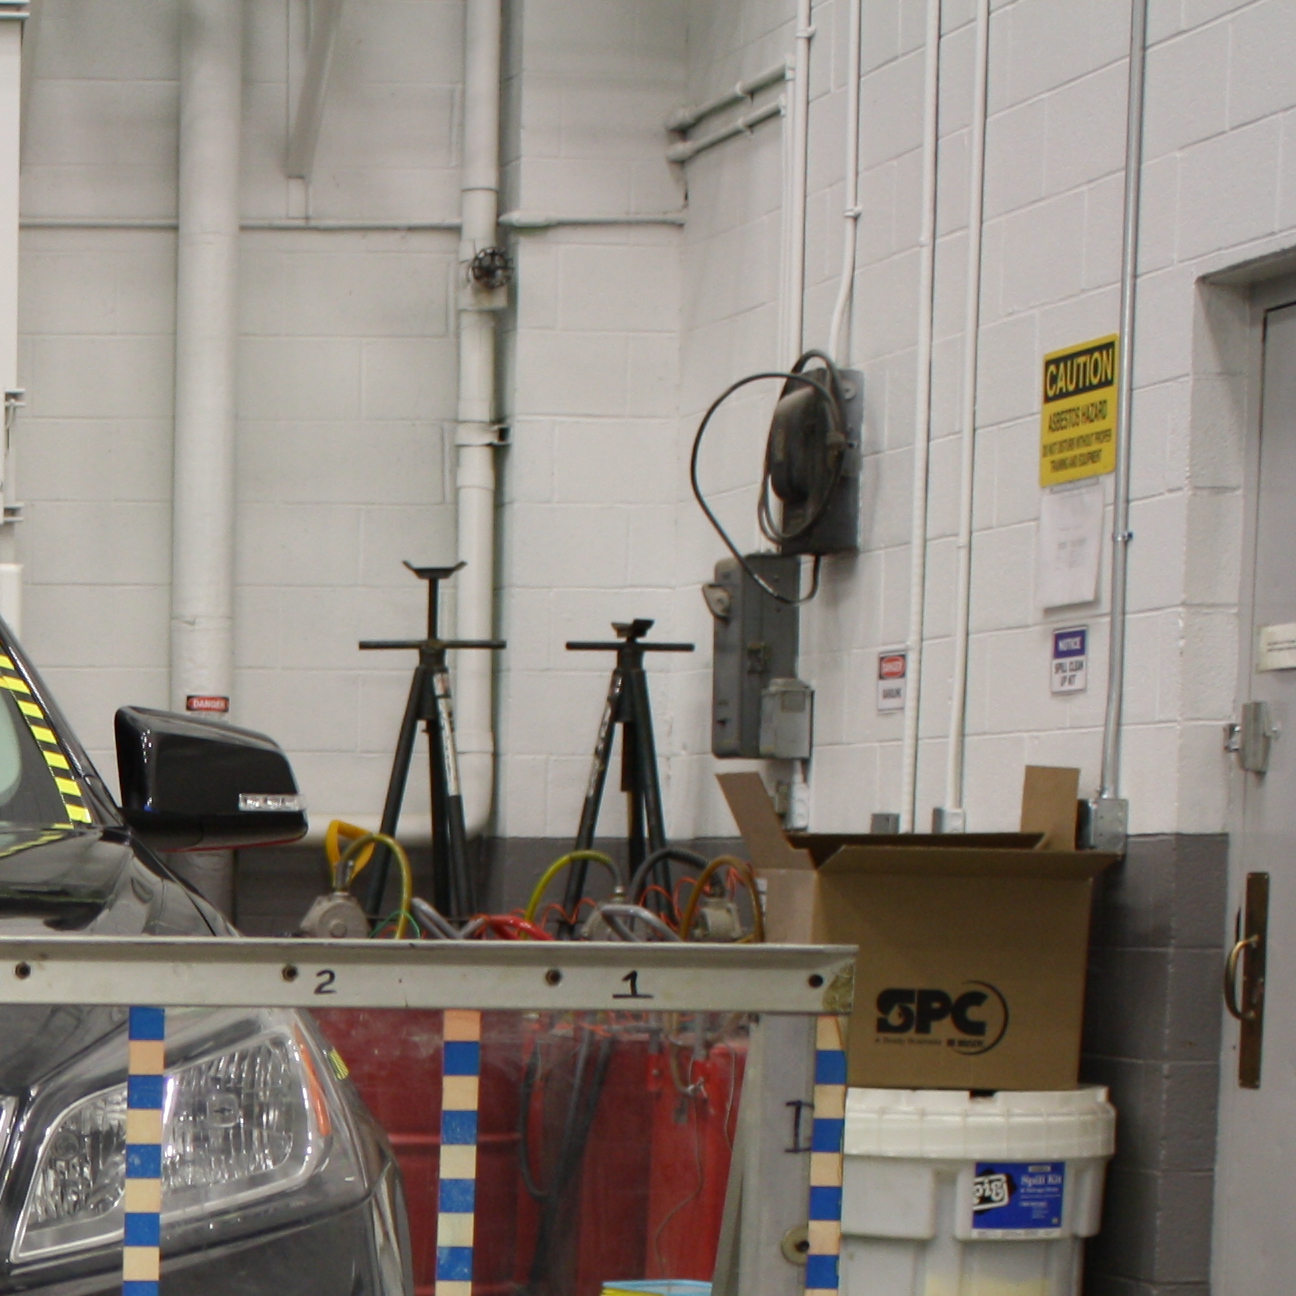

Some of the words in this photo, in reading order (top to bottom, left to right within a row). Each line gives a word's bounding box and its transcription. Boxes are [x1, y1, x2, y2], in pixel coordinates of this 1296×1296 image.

[1046, 348, 1112, 397] CAUTION
[313, 969, 337, 995] 2
[612, 970, 654, 999] 1
[876, 988, 988, 1036] SPC
[1020, 1175, 1045, 1188] Spill
[1047, 1174, 1062, 1185] Kit
